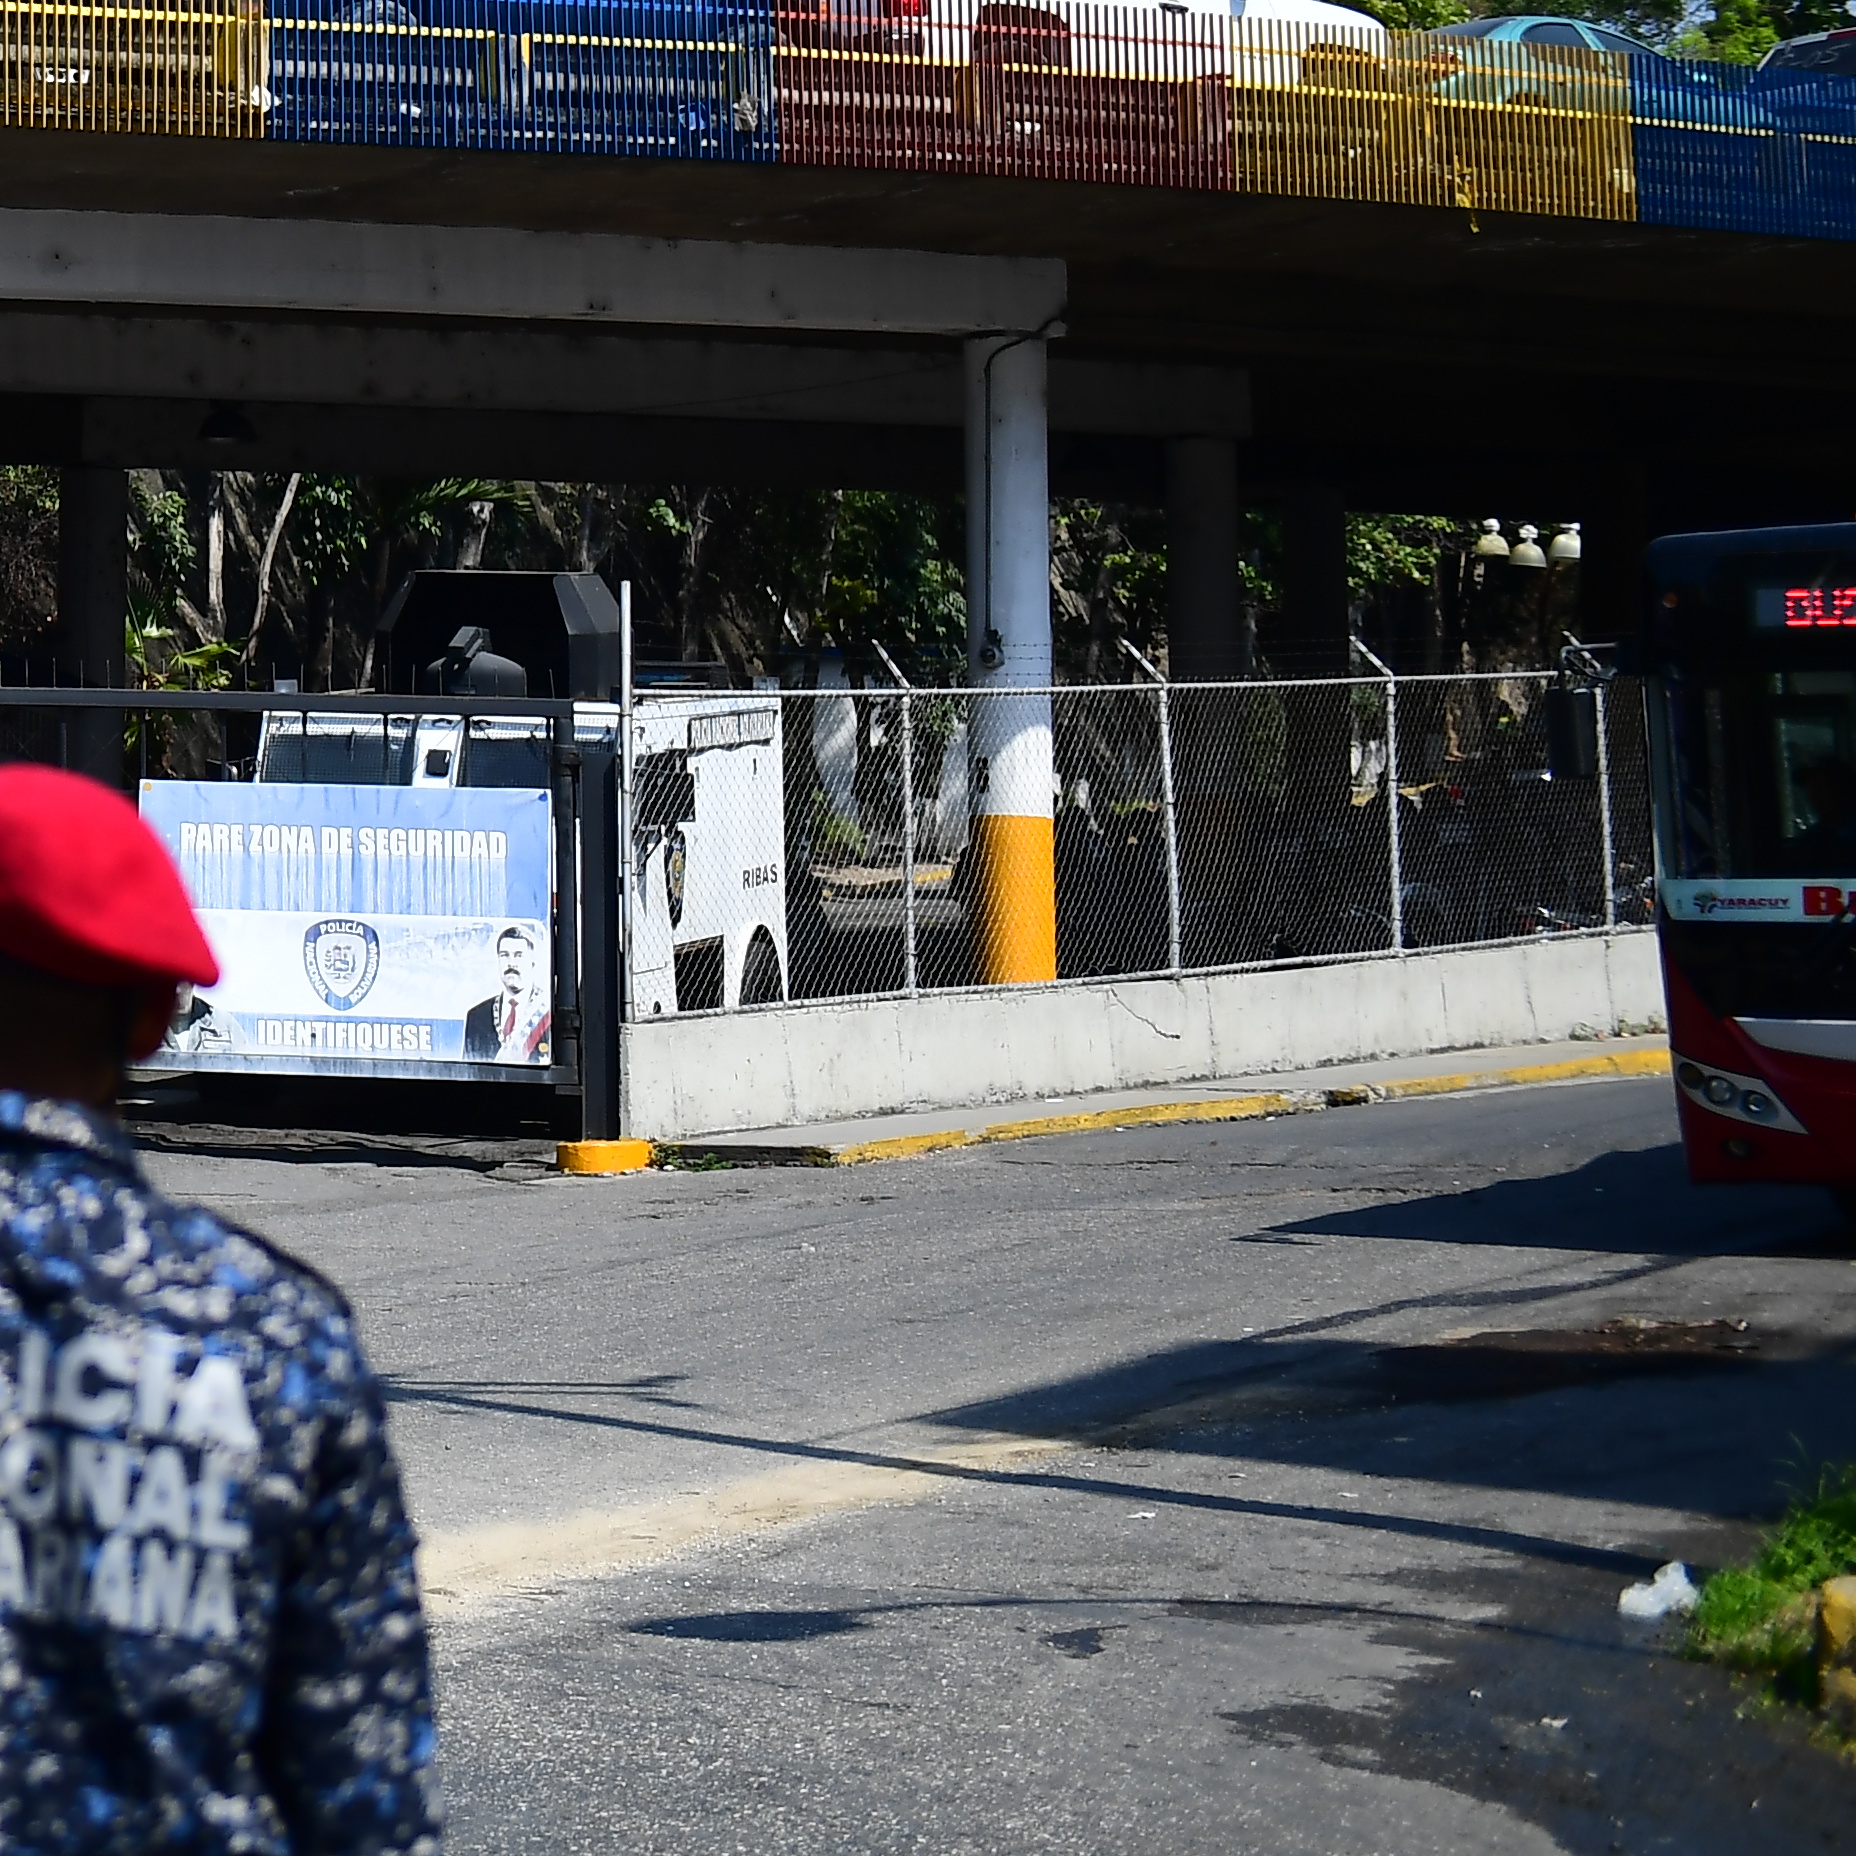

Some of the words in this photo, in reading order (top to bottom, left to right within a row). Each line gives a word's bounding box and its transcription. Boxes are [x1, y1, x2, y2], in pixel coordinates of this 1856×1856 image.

[180, 822, 244, 852] PARE
[249, 824, 316, 854] ZONA
[321, 826, 354, 855] DE
[358, 827, 508, 859] SEGURIDAD
[742, 863, 778, 890] RIBAS
[1717, 898, 1789, 907] YARACUY
[256, 1019, 433, 1052] IDENTIFIQUESE
